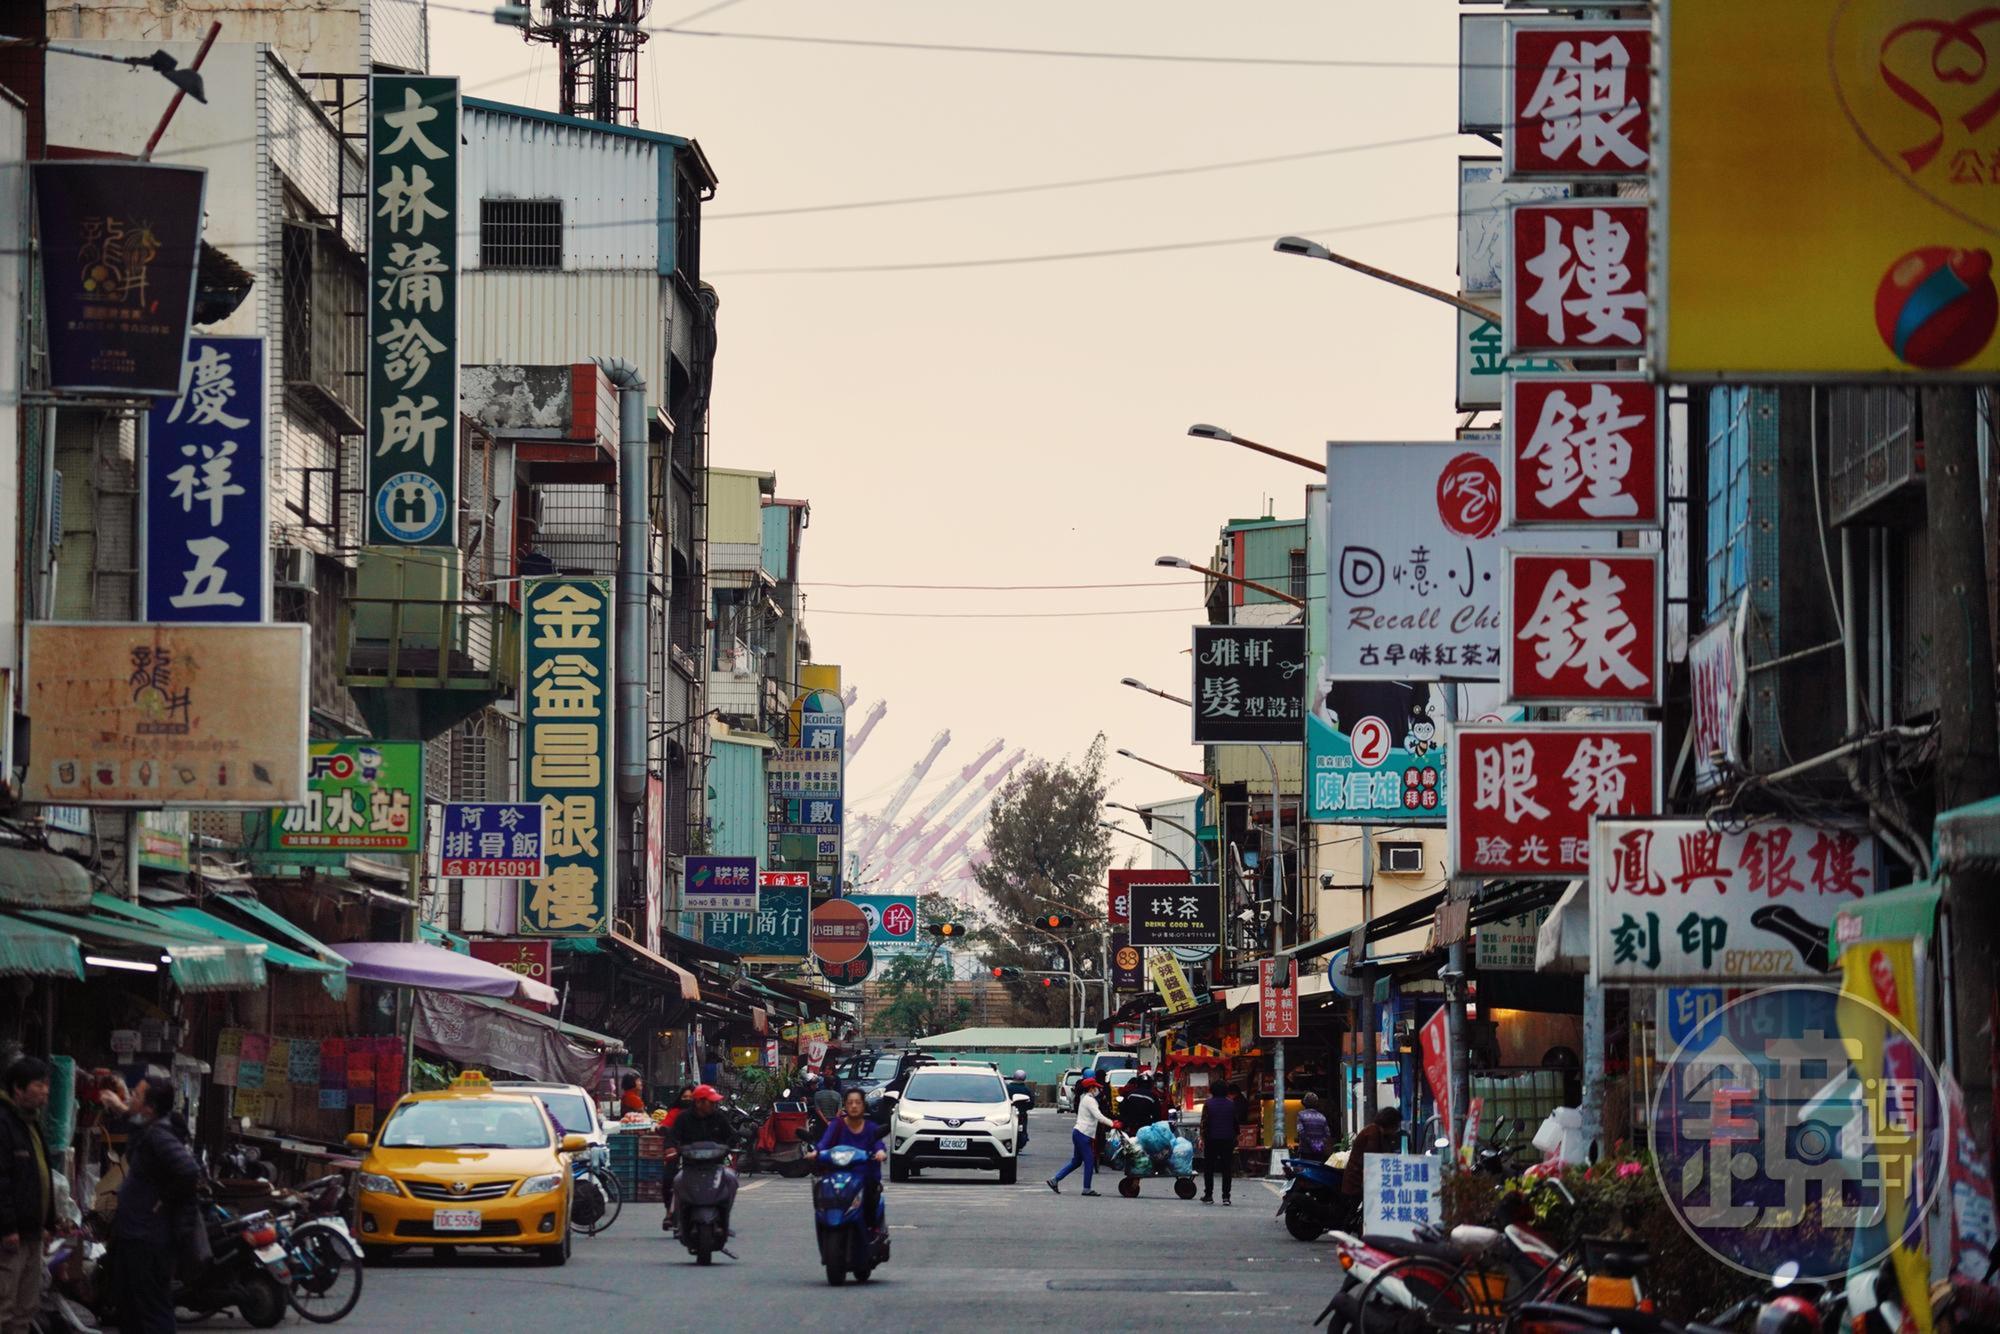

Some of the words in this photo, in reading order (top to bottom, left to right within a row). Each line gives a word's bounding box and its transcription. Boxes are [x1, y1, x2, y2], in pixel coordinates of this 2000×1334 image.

[1950, 149, 2000, 185] 公
[376, 87, 450, 466] 大林蒲診所
[1347, 606, 1440, 631] Recall
[1200, 638, 1274, 668] 雅軒
[804, 714, 842, 724] Konica
[1361, 723, 1380, 759] 2
[530, 585, 601, 929] 金益昌銀樓
[1316, 771, 1402, 811] 陳信雄
[1473, 738, 1637, 818] 眼鏡
[282, 787, 411, 833] 加水站
[460, 806, 525, 832] 阿玲
[446, 832, 539, 858] 排骨飯
[468, 861, 535, 876] 8715091
[1606, 828, 1872, 898] 鳳興銀樓
[887, 907, 912, 932] 玲
[1151, 896, 1200, 919] 找茶
[1610, 911, 1728, 970] 刻印
[1725, 948, 1795, 973] 8712372
[1380, 1189, 1429, 1205] 燒仙草
